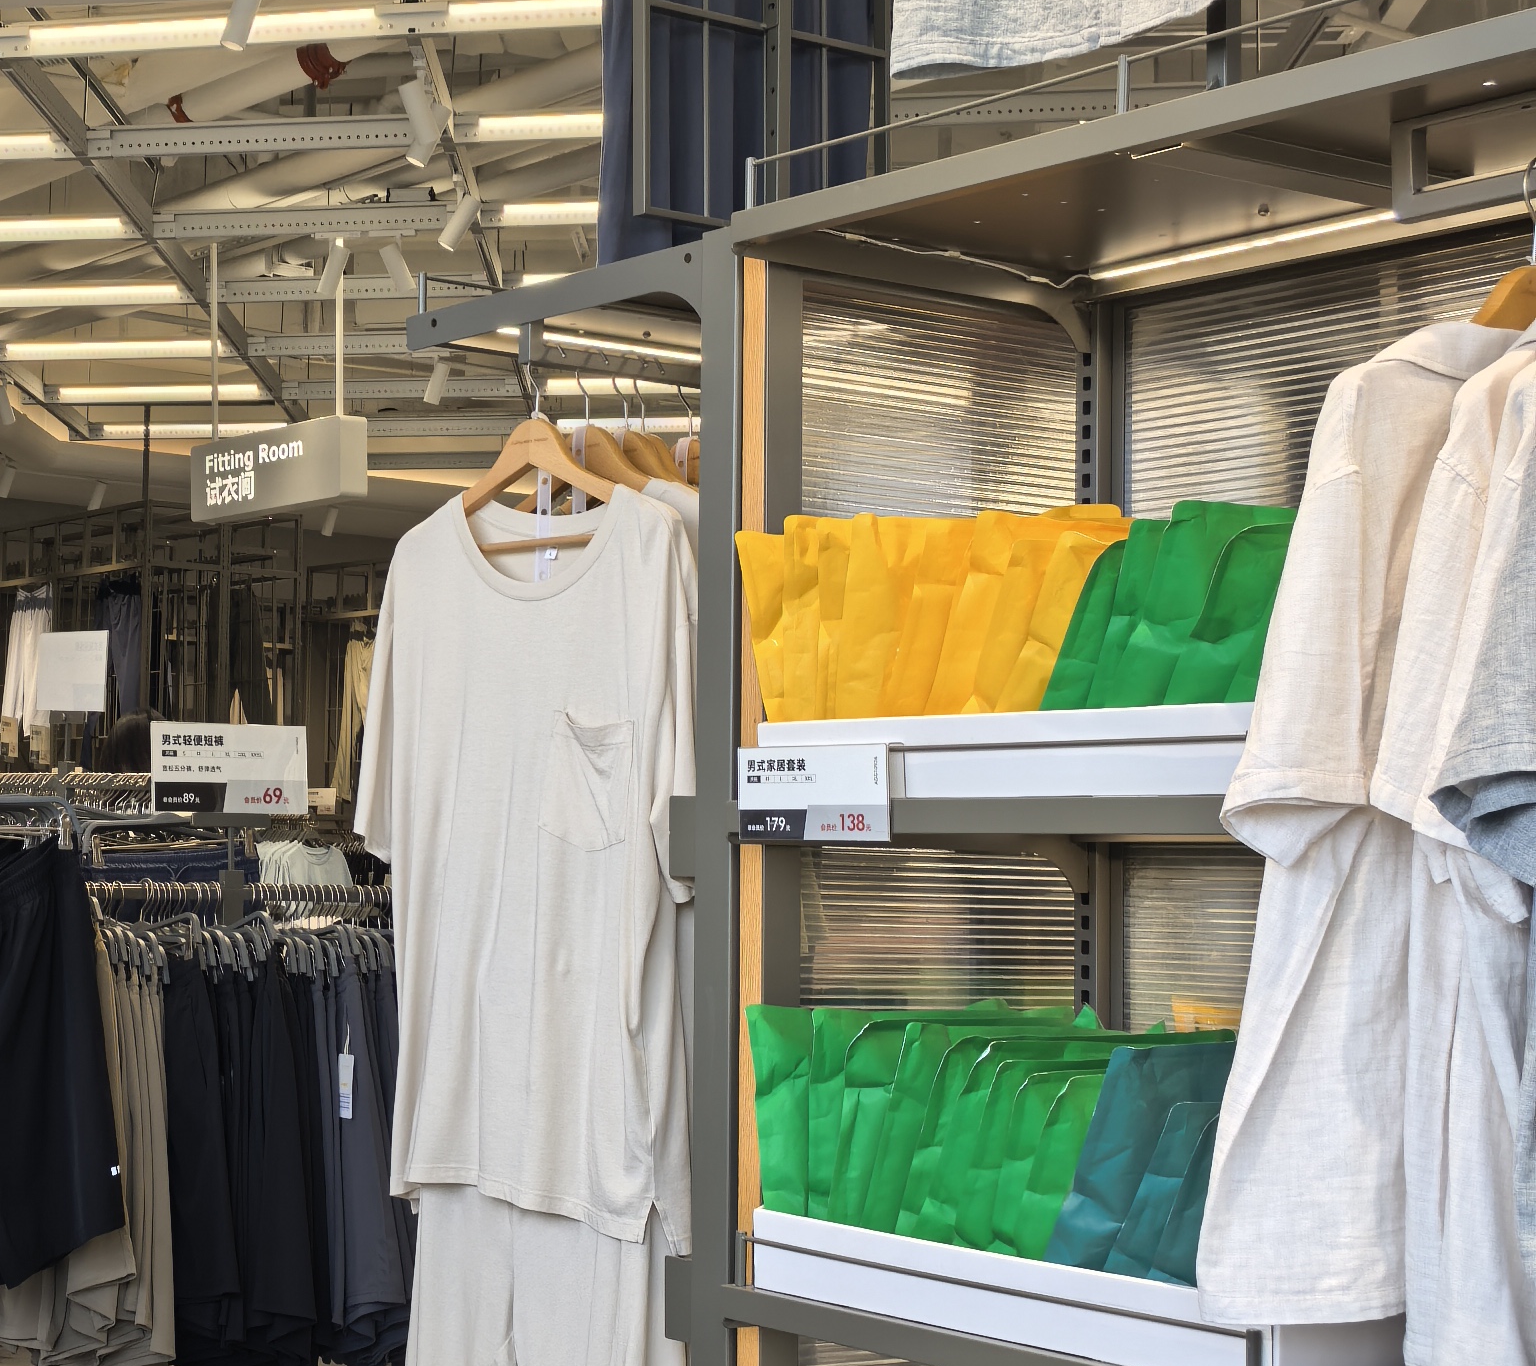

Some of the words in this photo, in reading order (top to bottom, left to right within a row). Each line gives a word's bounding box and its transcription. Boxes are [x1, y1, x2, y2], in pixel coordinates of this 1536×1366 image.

[205, 450, 254, 475] Fitting
[258, 439, 304, 464] Room
[205, 470, 255, 507] 试衣间
[161, 733, 225, 747] 男式轻便短裤
[747, 757, 806, 773] 男式家居套装
